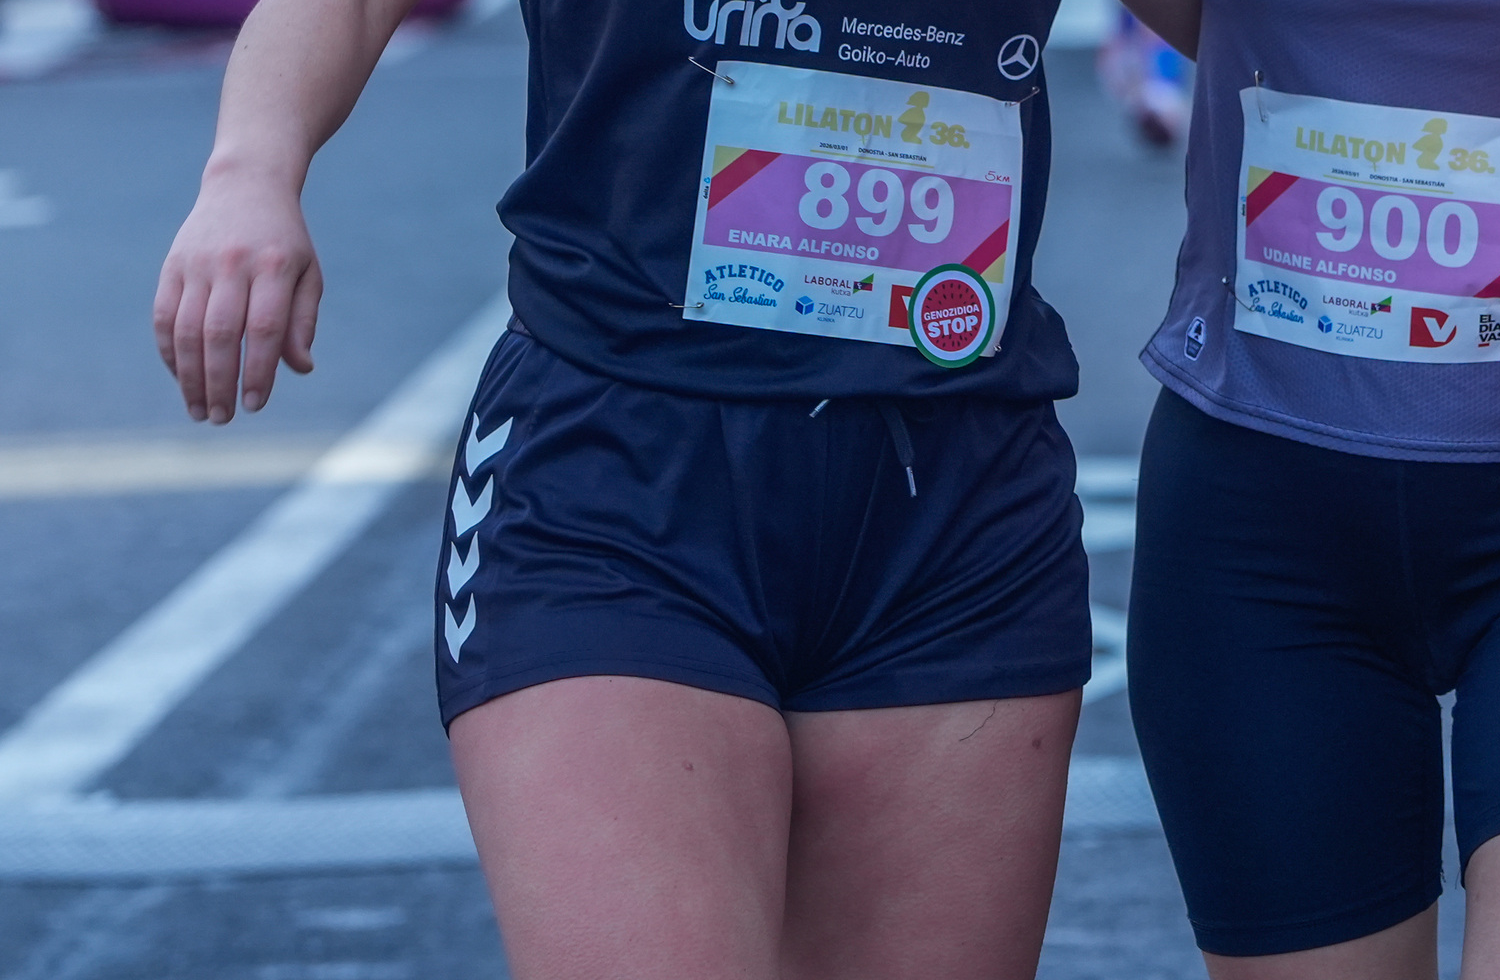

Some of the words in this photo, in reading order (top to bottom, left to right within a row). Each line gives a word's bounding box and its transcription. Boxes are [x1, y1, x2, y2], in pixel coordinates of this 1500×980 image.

[840, 15, 967, 48] Mercedes-Benz
[777, 101, 894, 141] LILATON
[928, 121, 971, 150] 36.
[857, 146, 885, 158] DONOSTIA
[888, 150, 900, 160] SAN
[1294, 125, 1407, 167] LILATON
[1446, 146, 1497, 175] 36.
[1369, 173, 1399, 184] DONOSTIA
[1401, 177, 1415, 186] SAN
[798, 161, 956, 245] 899
[1314, 186, 1480, 268] 900
[727, 228, 793, 251] ENARA
[796, 237, 881, 262] ALFONSO
[1262, 246, 1312, 271] UDANE
[1315, 259, 1398, 284] ALFONSO
[703, 263, 786, 294] ATLETICO
[803, 274, 853, 290] LABORAL
[702, 283, 727, 302] San
[728, 285, 778, 309] Sebastian
[830, 287, 852, 298] kutxa
[1247, 278, 1309, 311] ATLETICO
[1322, 294, 1370, 311] LABORAL
[816, 301, 866, 320] ZUATZU
[922, 303, 981, 322] GENOZIDIOA
[1479, 313, 1496, 324] EL
[926, 314, 980, 339] STOP
[1335, 321, 1384, 340] ZUATZU
